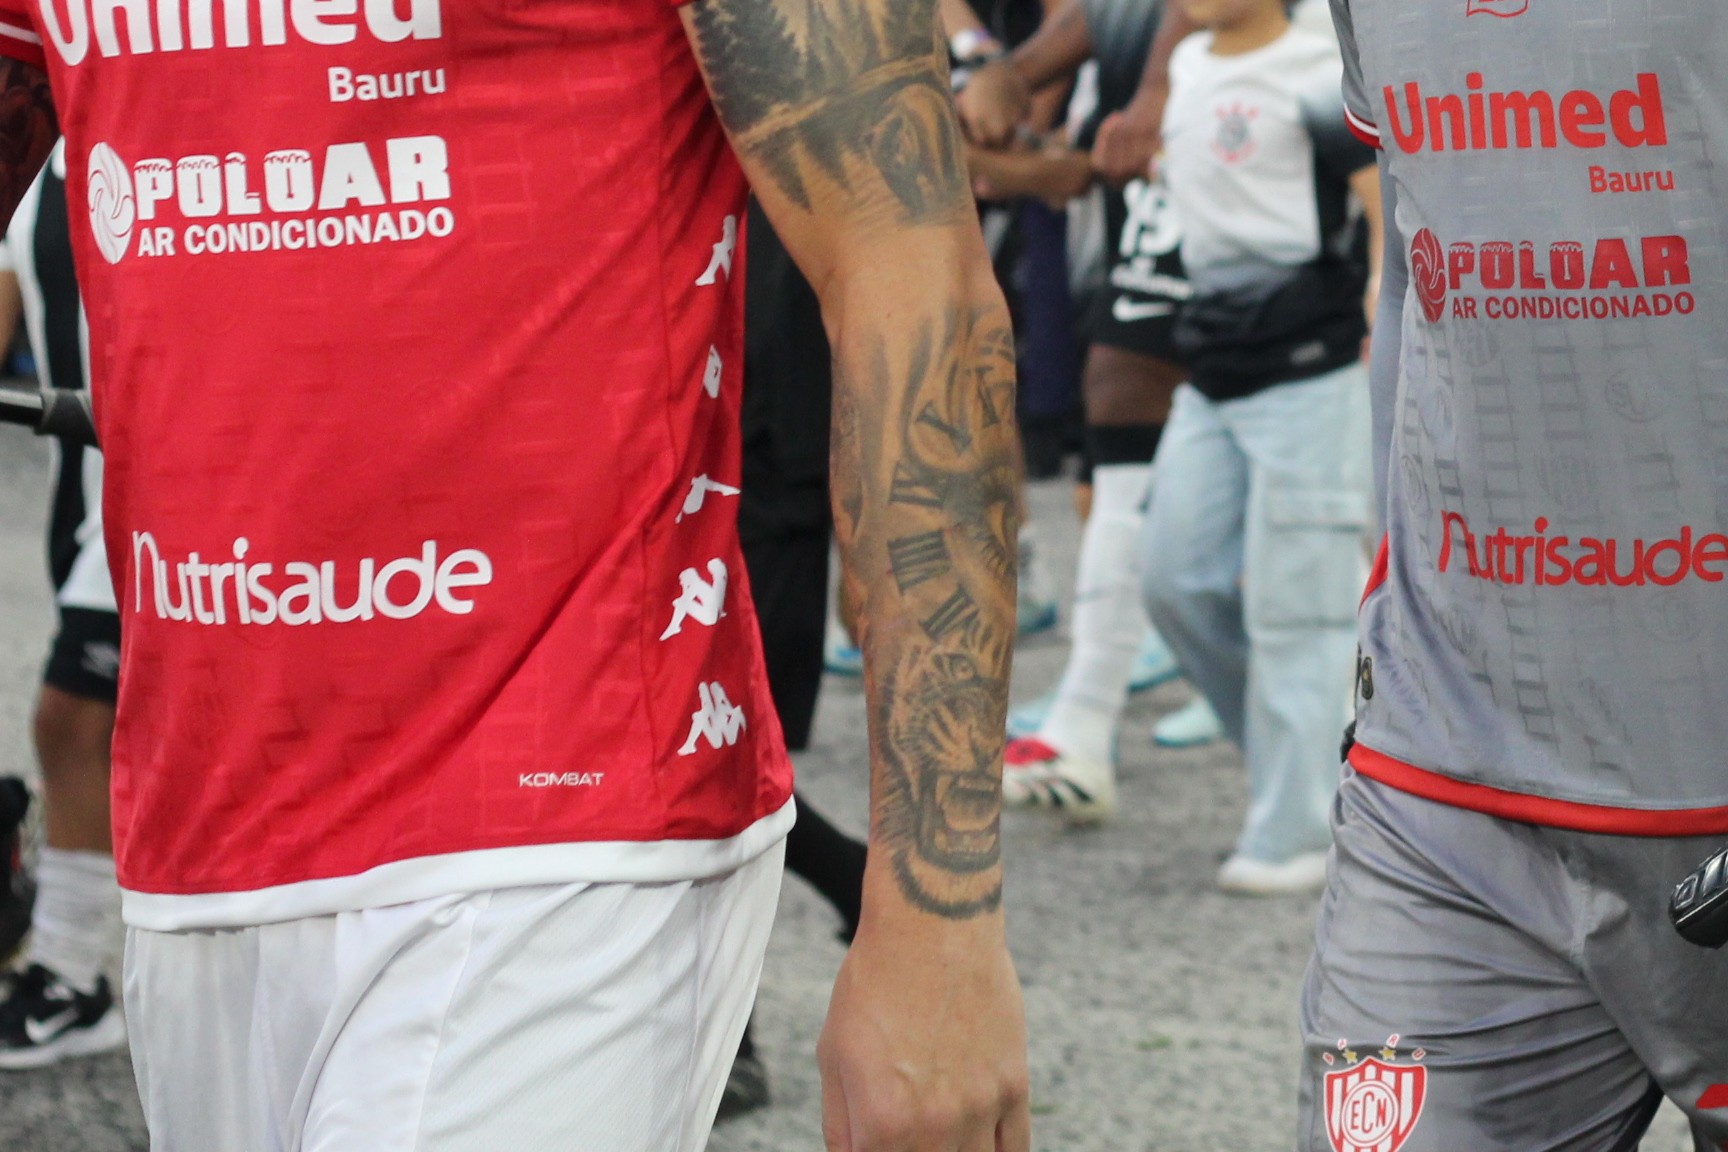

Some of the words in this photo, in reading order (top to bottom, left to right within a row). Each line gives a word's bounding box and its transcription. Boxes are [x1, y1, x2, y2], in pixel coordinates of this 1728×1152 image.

[328, 67, 446, 102] Bauru
[1382, 72, 1668, 155] Unimed
[1588, 165, 1675, 193] Bauru
[137, 226, 175, 257] AR
[184, 206, 454, 256] CONDICIONADO
[1453, 296, 1478, 319] AR
[1485, 291, 1695, 319] CONDICIONADO
[519, 772, 604, 788] KOMBAT
[1351, 1091, 1388, 1134] ECN
